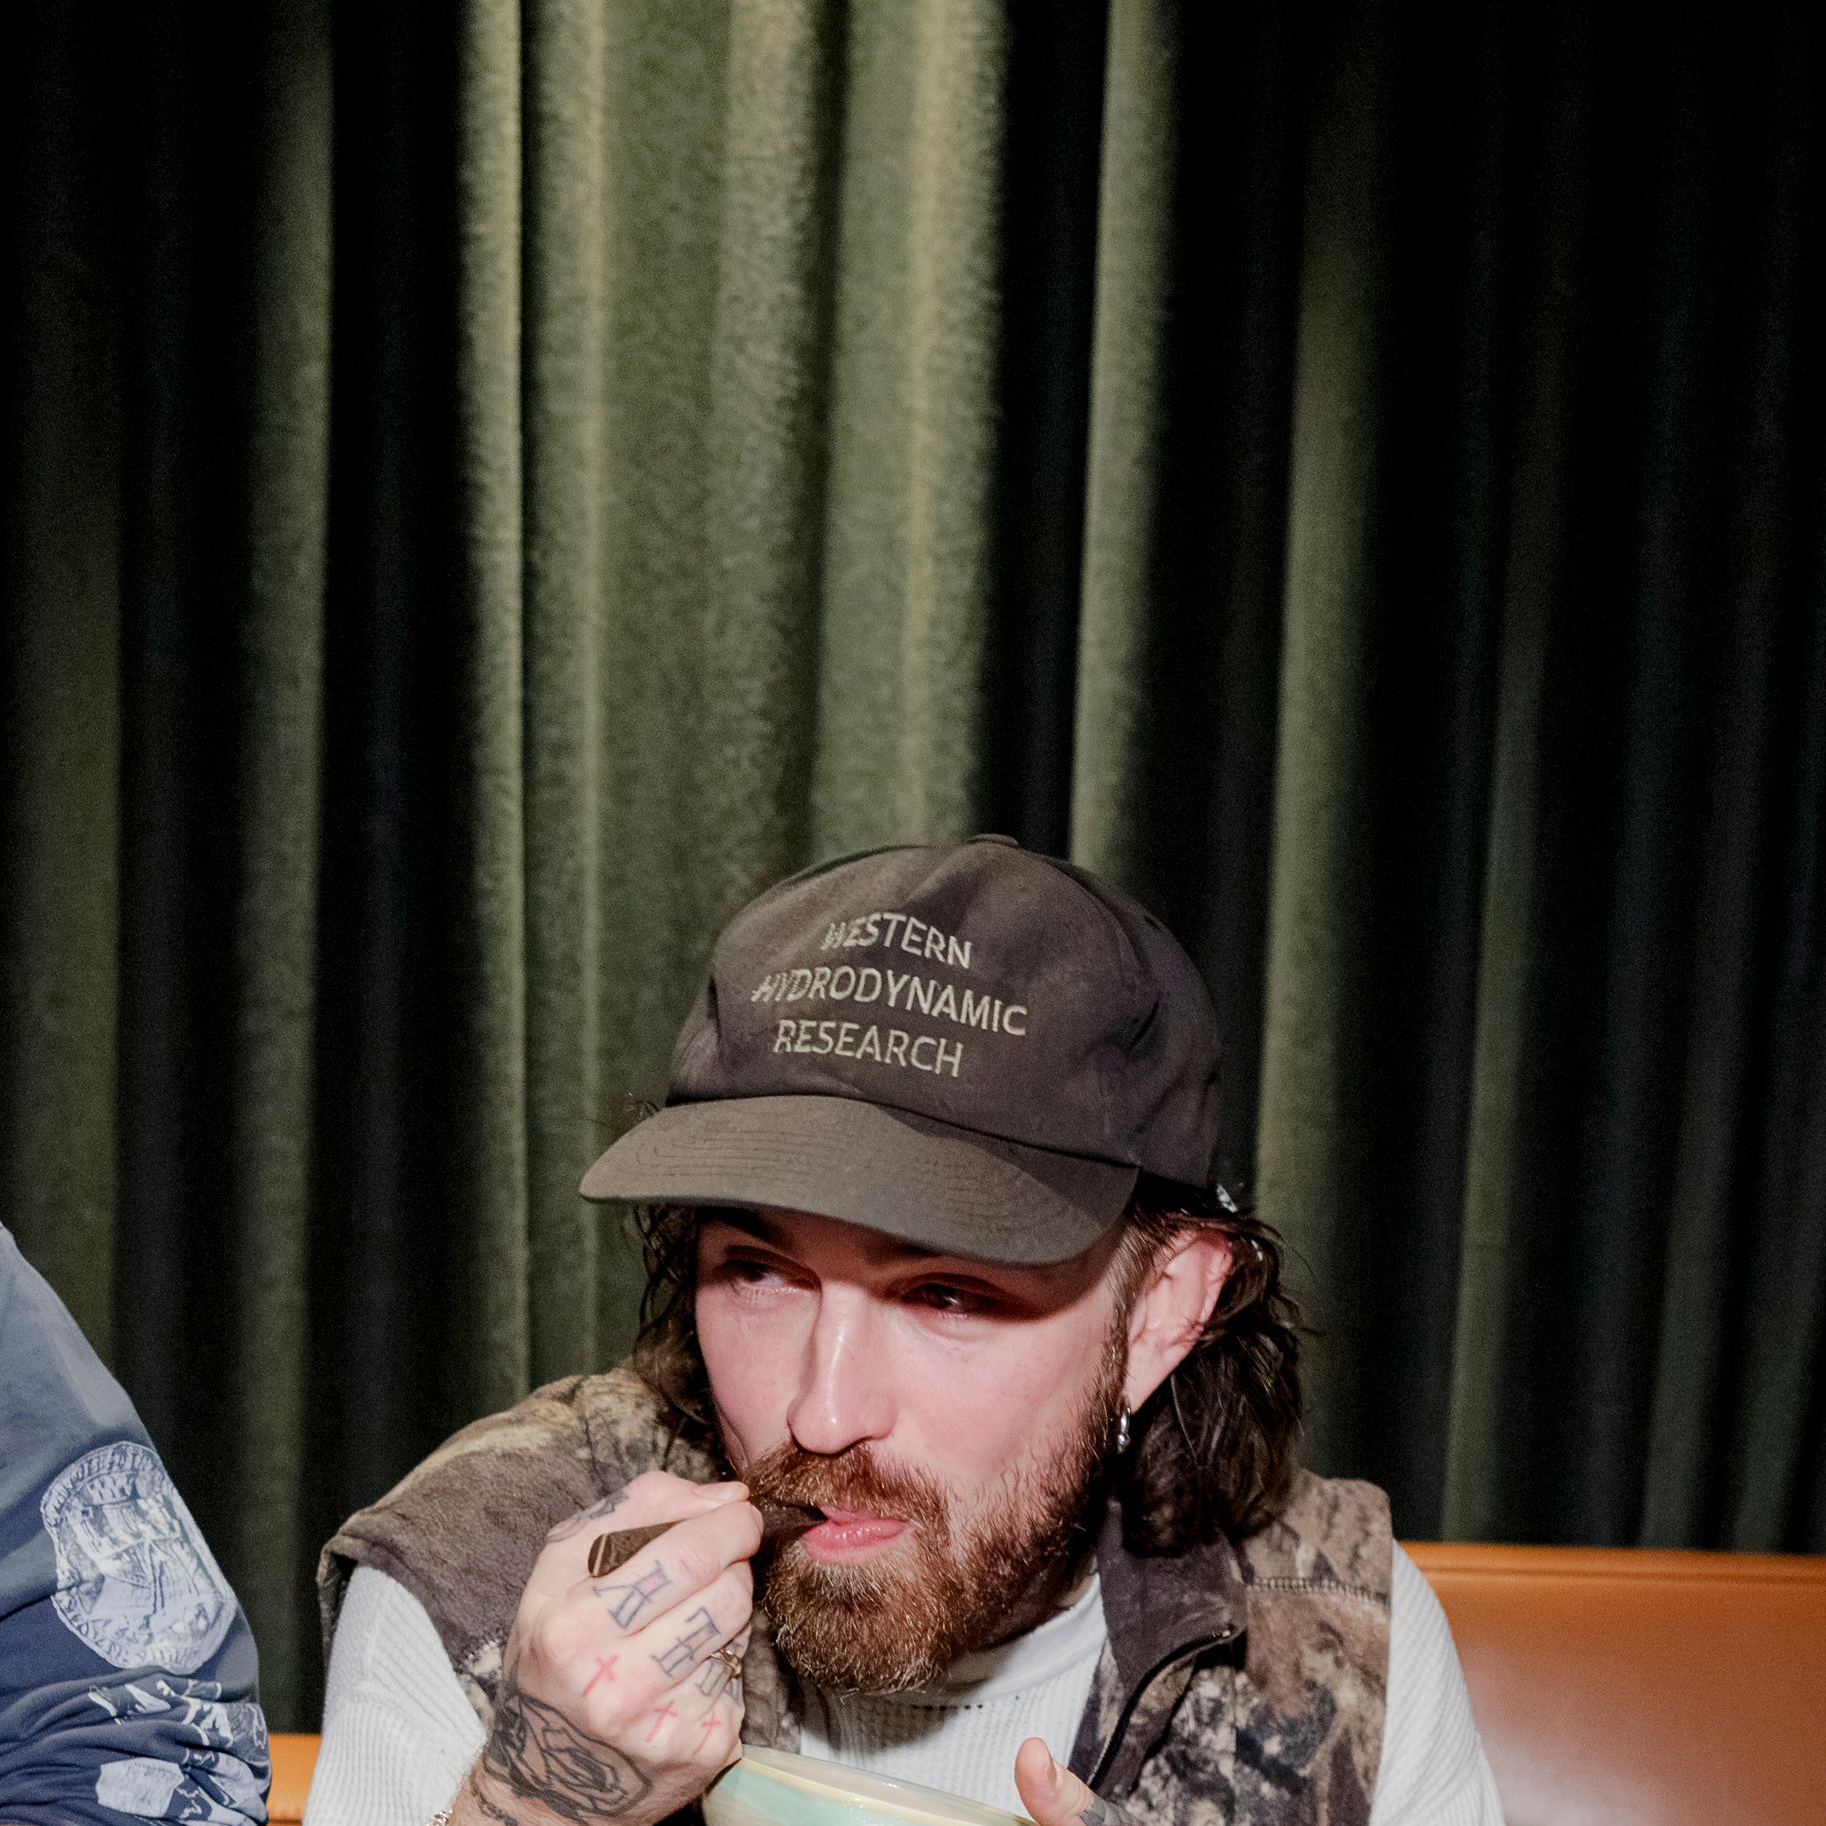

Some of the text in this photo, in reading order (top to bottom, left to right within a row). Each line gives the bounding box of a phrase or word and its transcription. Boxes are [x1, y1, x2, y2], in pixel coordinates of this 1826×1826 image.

[821, 911, 972, 970] WESTERN
[750, 965, 1028, 1036] HYDRODYNAMIC
[773, 1018, 965, 1078] RESEARCH
